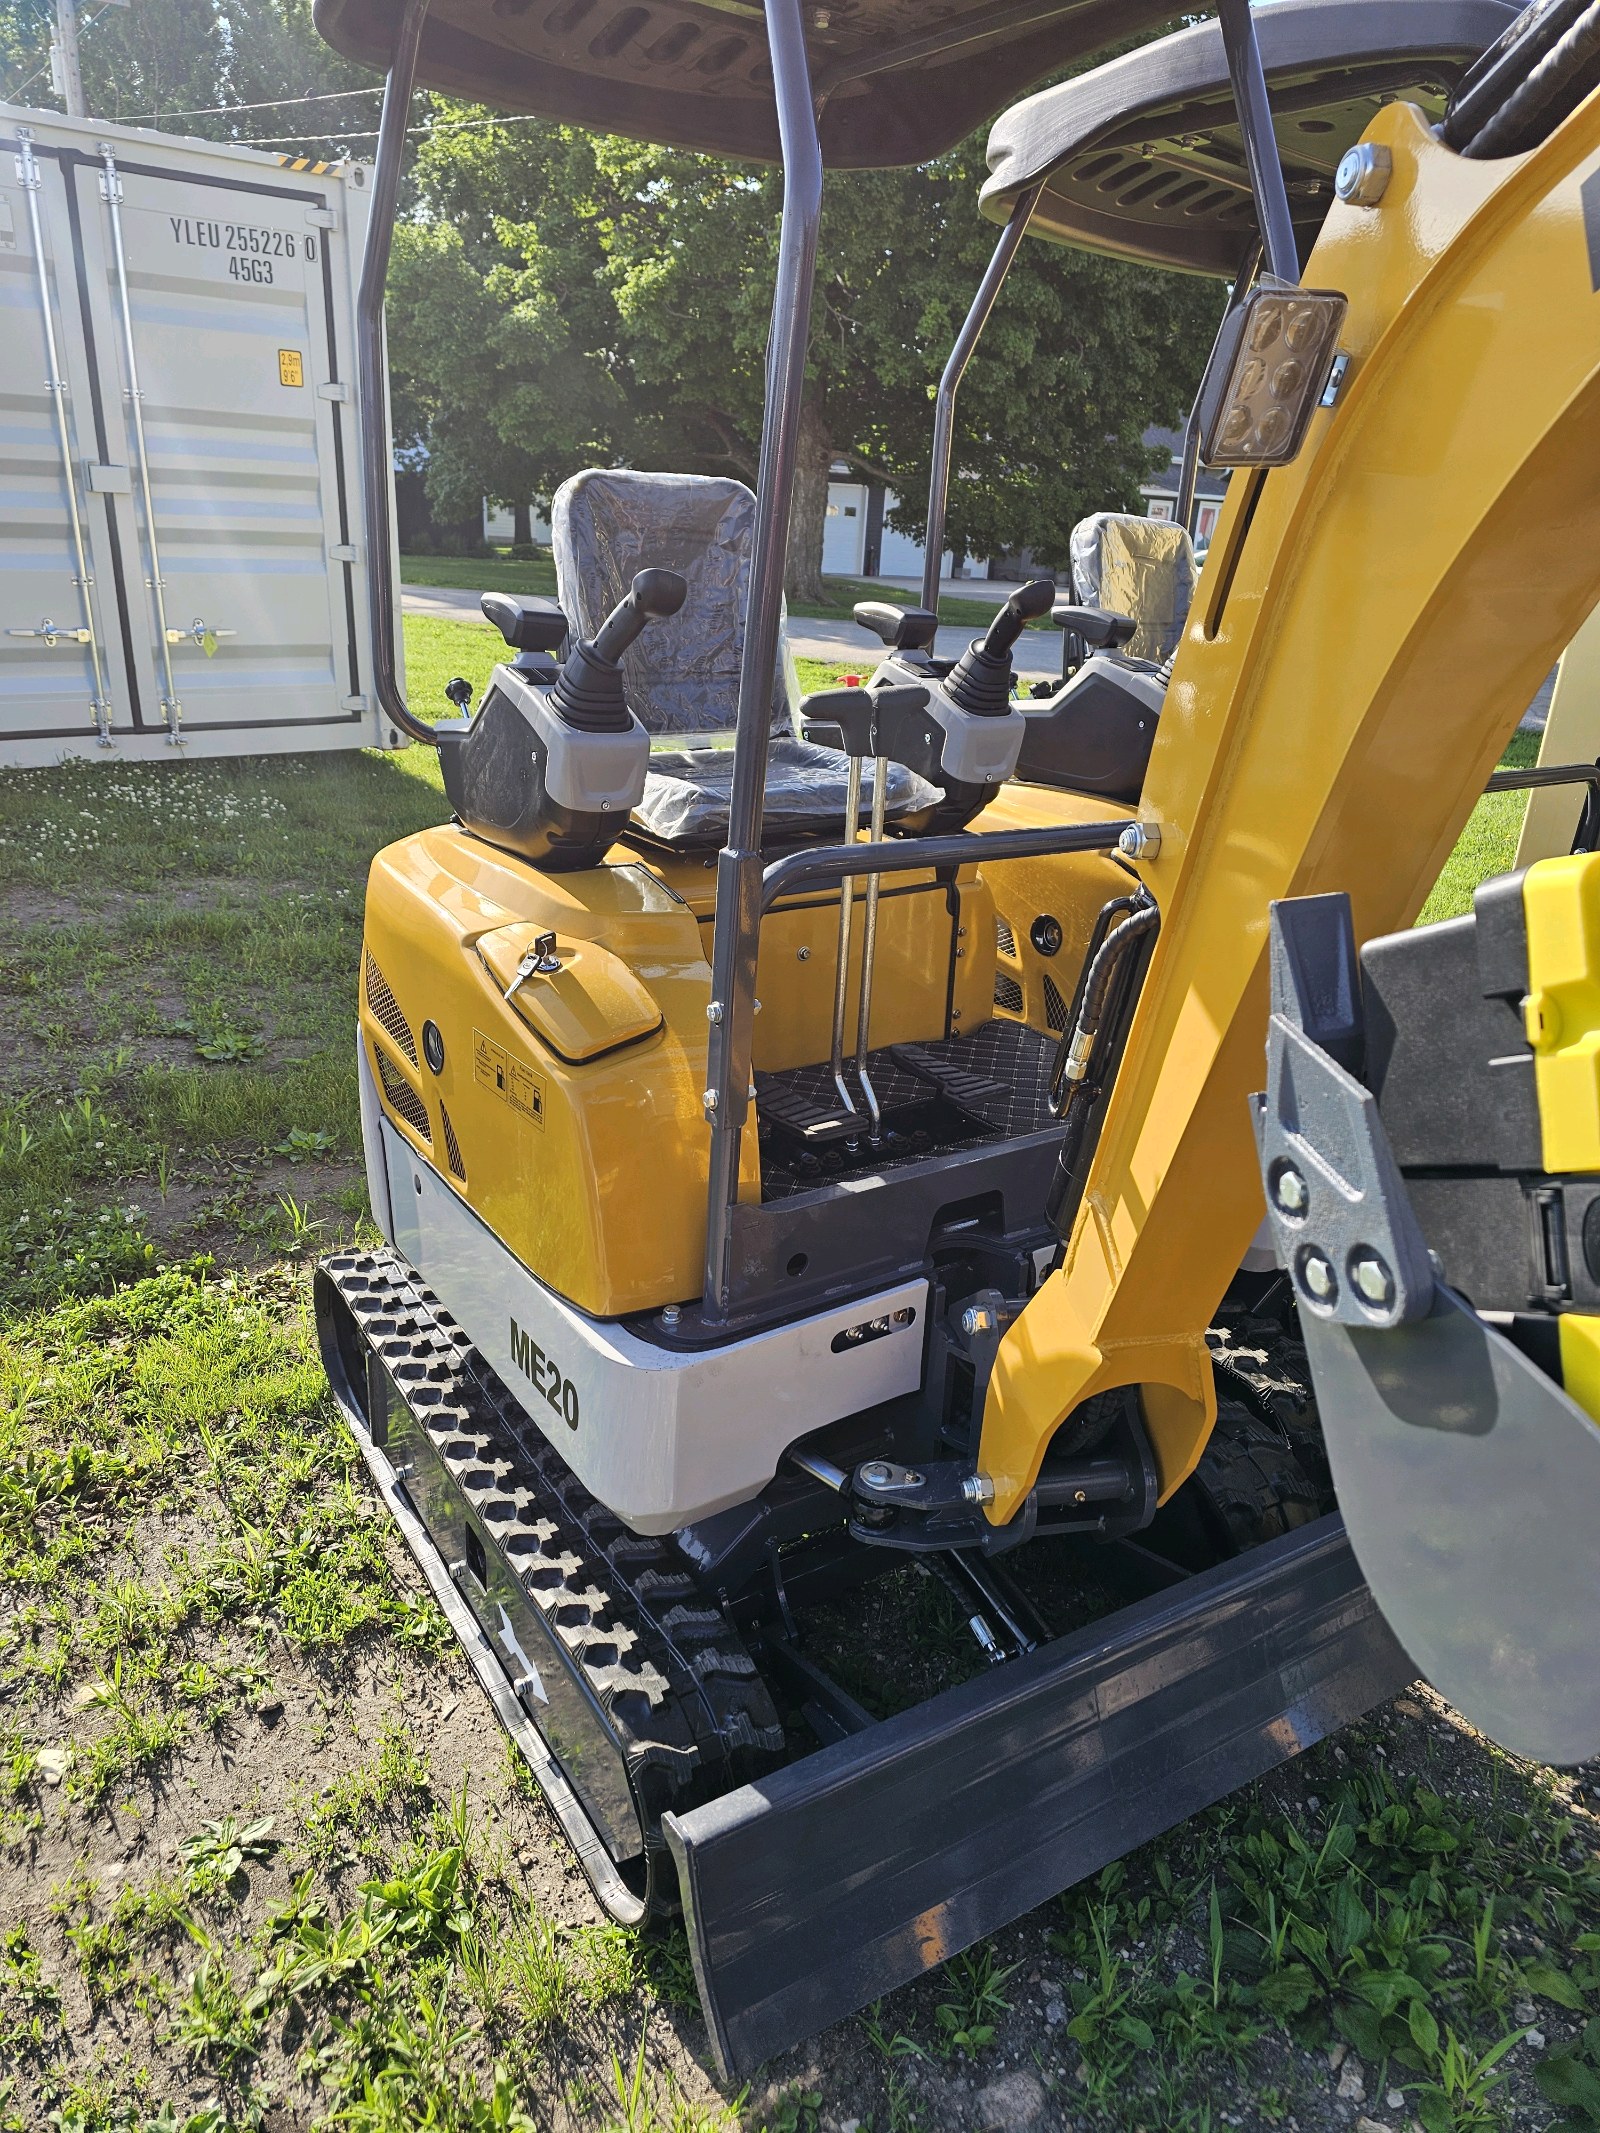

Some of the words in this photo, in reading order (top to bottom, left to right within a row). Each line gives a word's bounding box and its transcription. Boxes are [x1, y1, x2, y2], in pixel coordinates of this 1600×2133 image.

[170, 217, 220, 248] YLEU
[225, 225, 296, 258] 255226
[229, 256, 274, 284] 45G3
[510, 1316, 579, 1431] ME20
